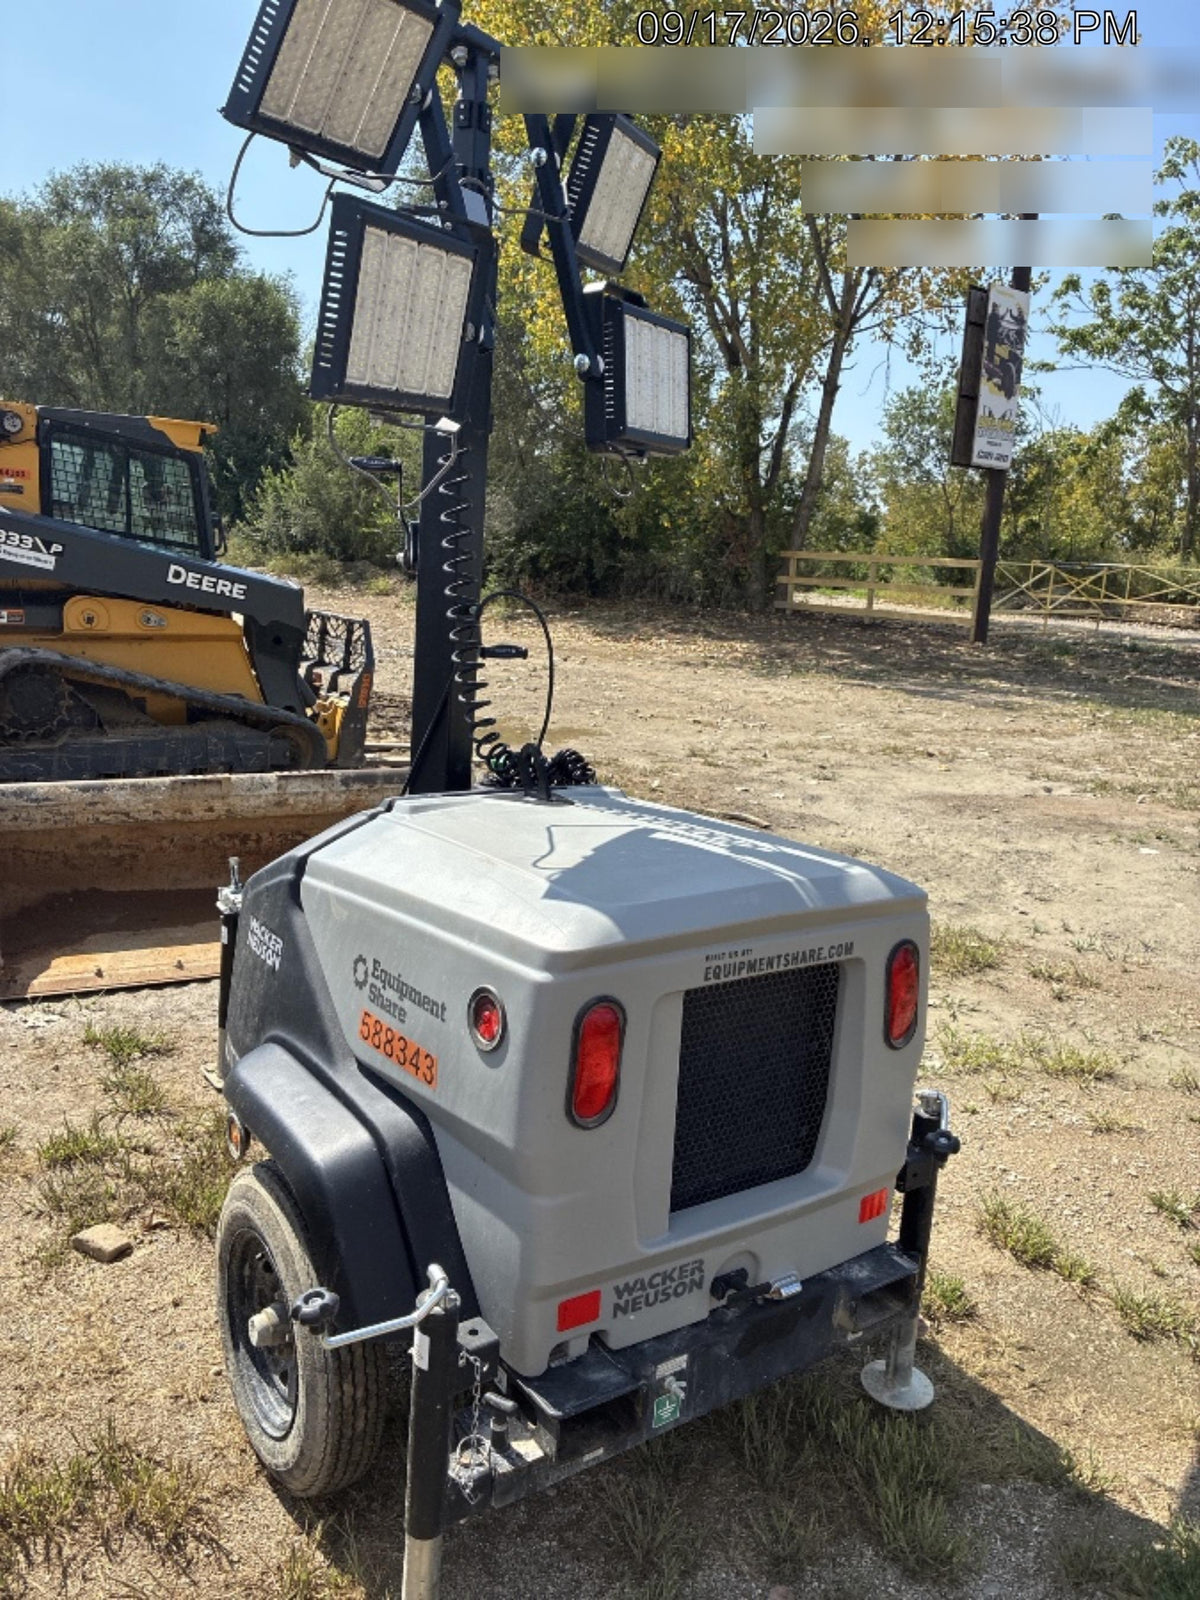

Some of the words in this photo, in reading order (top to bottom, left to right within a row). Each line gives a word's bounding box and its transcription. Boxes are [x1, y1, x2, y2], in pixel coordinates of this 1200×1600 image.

[166, 563, 248, 600] DEERE
[250, 915, 284, 956] WACKER
[703, 941, 855, 982] EQUIPMENTSHARE.COM
[368, 983, 407, 1025] Share
[370, 958, 448, 1023] Equipment
[360, 1011, 436, 1086] 588343
[611, 1274, 704, 1320] NEUSON
[613, 1258, 705, 1301] WACKER
